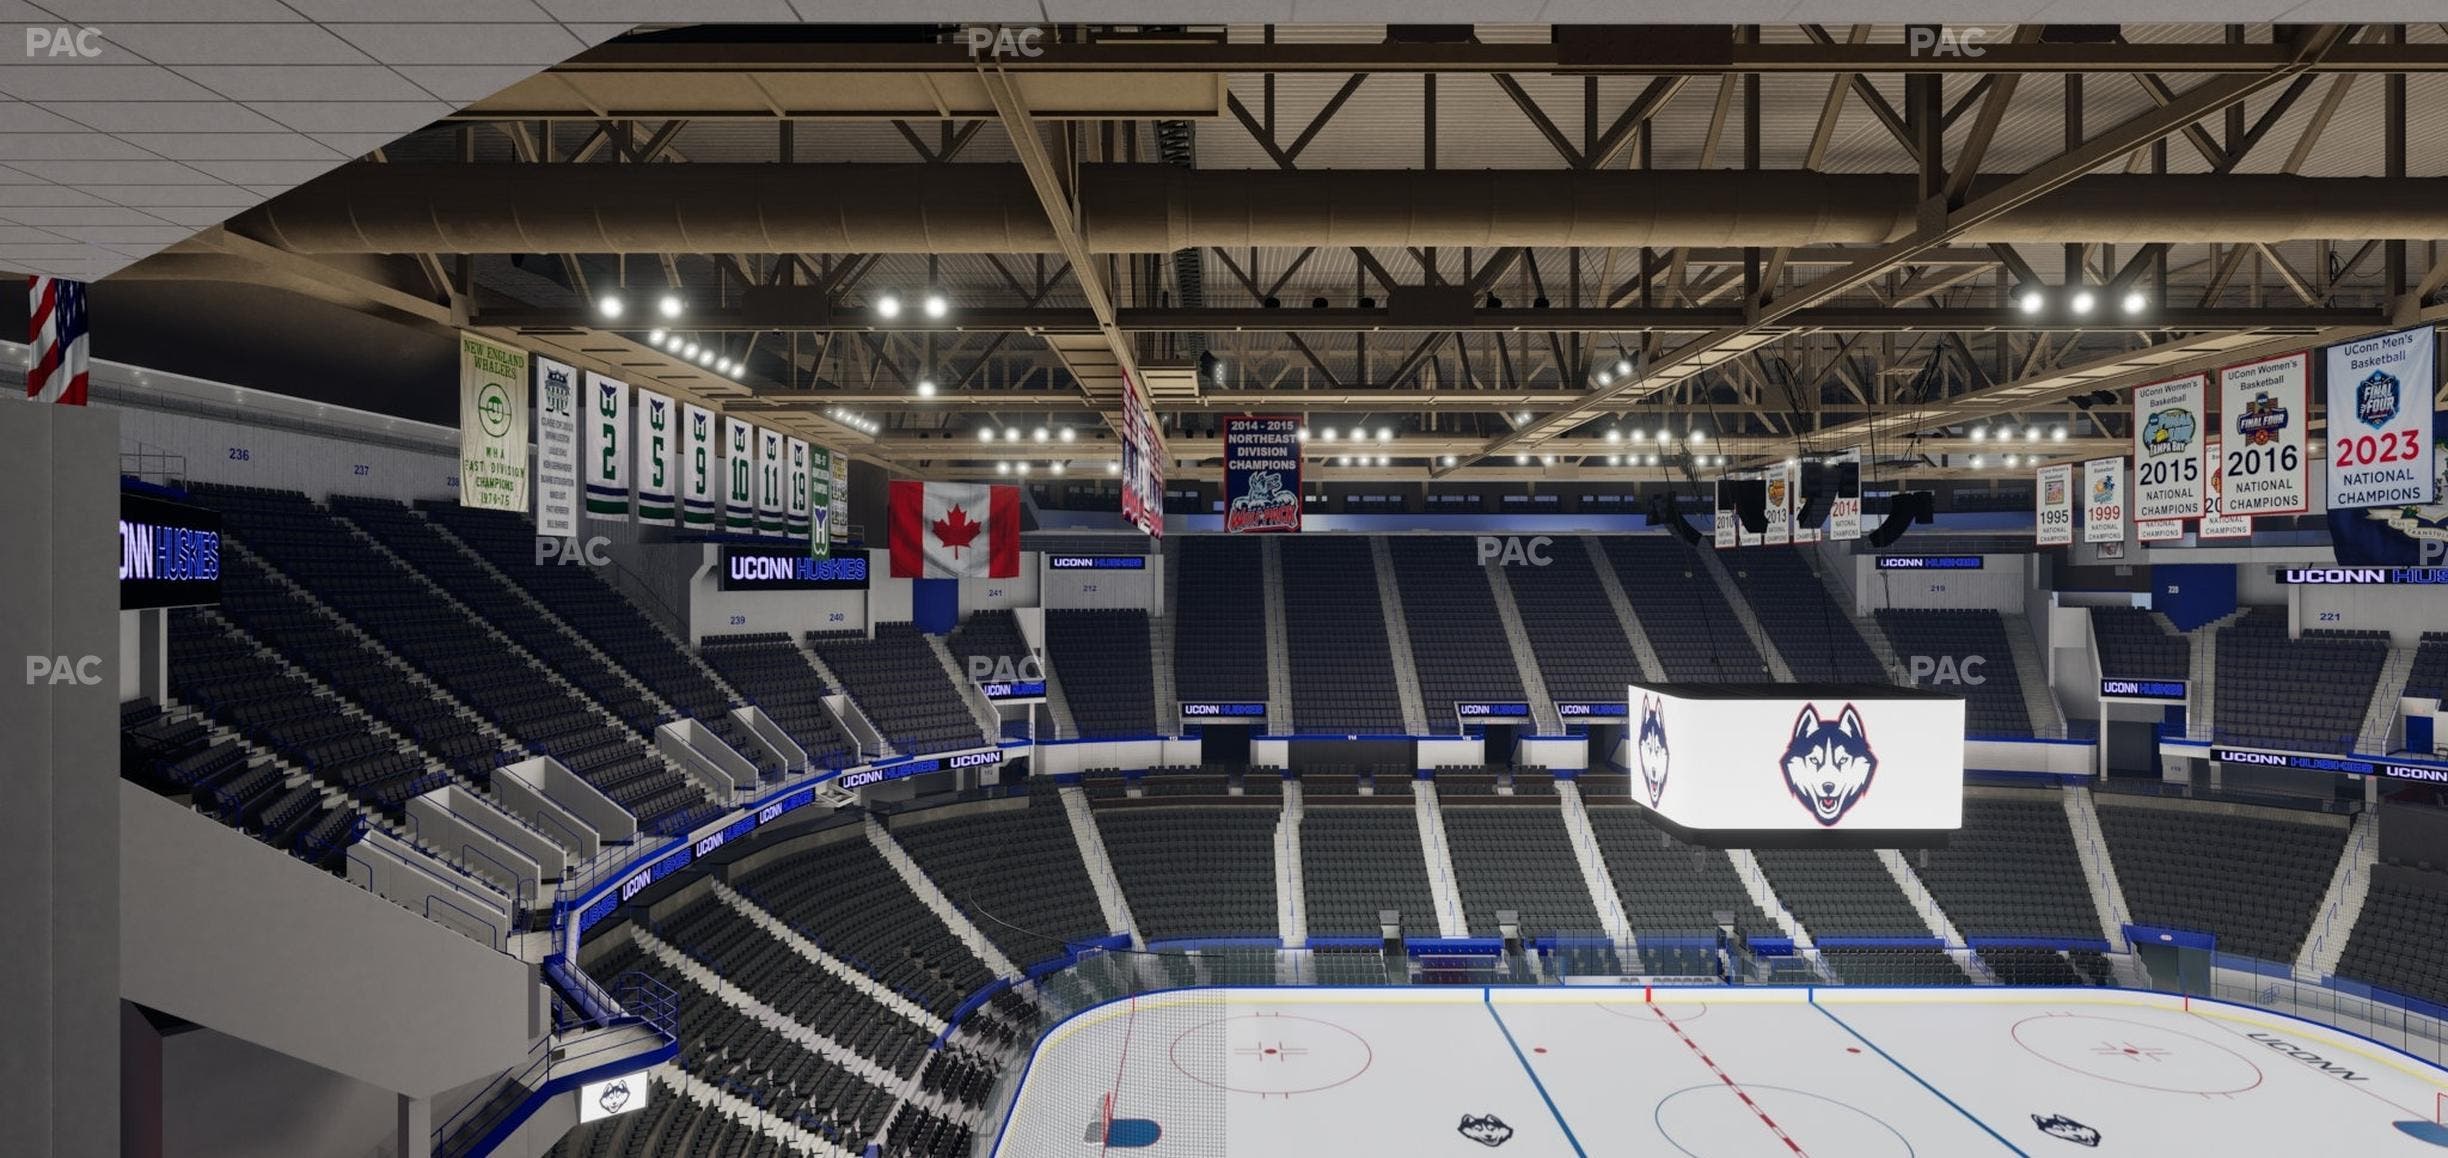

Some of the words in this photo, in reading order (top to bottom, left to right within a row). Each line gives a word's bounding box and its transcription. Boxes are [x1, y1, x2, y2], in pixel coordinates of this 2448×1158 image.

[464, 339, 484, 355] NEW
[488, 347, 524, 368] ENGLAND
[2345, 342, 2379, 356] UConn
[2382, 335, 2413, 349] Men's
[474, 355, 516, 380] WHALERS
[2351, 350, 2406, 370] Basketball
[2228, 370, 2256, 380] UConn
[2257, 360, 2297, 374] Women's
[2240, 375, 2284, 391] Basketball
[2139, 388, 2163, 398] UConn
[2364, 383, 2392, 400] FINAL
[2366, 397, 2394, 414] FOUR
[1231, 421, 1258, 430] 2014
[1267, 421, 1294, 430] 2015
[1228, 434, 1298, 443] NORTHEAST
[229, 447, 249, 461] 236
[602, 423, 616, 480] 2
[1237, 447, 1288, 457] DIVISION
[2336, 429, 2419, 468] 2023
[464, 460, 484, 473] EAST
[491, 462, 525, 478] DIVISION
[652, 435, 664, 488] 5
[1228, 460, 1296, 470] CHAMPIONS
[2228, 445, 2298, 477] 2016
[354, 465, 369, 476] 237
[695, 446, 706, 495] 9
[732, 456, 749, 501] 10
[2140, 457, 2198, 485] 2015
[2344, 468, 2414, 486] NATIONAL
[476, 476, 514, 492] CHAMPIONS
[764, 464, 778, 506] 11
[792, 470, 806, 510] 19
[2236, 479, 2293, 493] NATIONAL
[2146, 488, 2194, 501] NATIONAL
[2230, 495, 2299, 510] CHAMPIONS
[2338, 487, 2421, 505] CHAMPIONS
[1833, 500, 1858, 517] 2014
[2040, 509, 2069, 524] 1995
[2088, 505, 2120, 522] 1999
[2142, 503, 2198, 516] CHAMPIONS
[2205, 526, 2247, 534] CHAMPIONS
[156, 526, 218, 581] HUSKIES
[731, 556, 793, 580] UCONN
[796, 557, 866, 580] HUSKIES
[1054, 558, 1093, 567] UCONN
[1881, 558, 1923, 567] UCONN
[2286, 569, 2385, 583] UCONN
[989, 589, 1002, 597] 241
[730, 616, 746, 625] 239
[829, 613, 844, 622] 240
[2320, 613, 2341, 621] 221
[983, 684, 1011, 696] UCONN
[2104, 682, 2138, 693] UCONN
[1185, 705, 1219, 714] UCONN
[1461, 705, 1490, 714] UCONN
[1561, 705, 1590, 714] UCONN
[950, 752, 1000, 768] UCONN
[2221, 751, 2286, 766] UCONN
[843, 769, 883, 788] UCONN
[2386, 765, 2448, 782] UCONN
[759, 803, 782, 824] UCONN
[697, 832, 723, 857] UCONN
[623, 868, 651, 901] UCONN
[2246, 1033, 2370, 1081] UCONN
